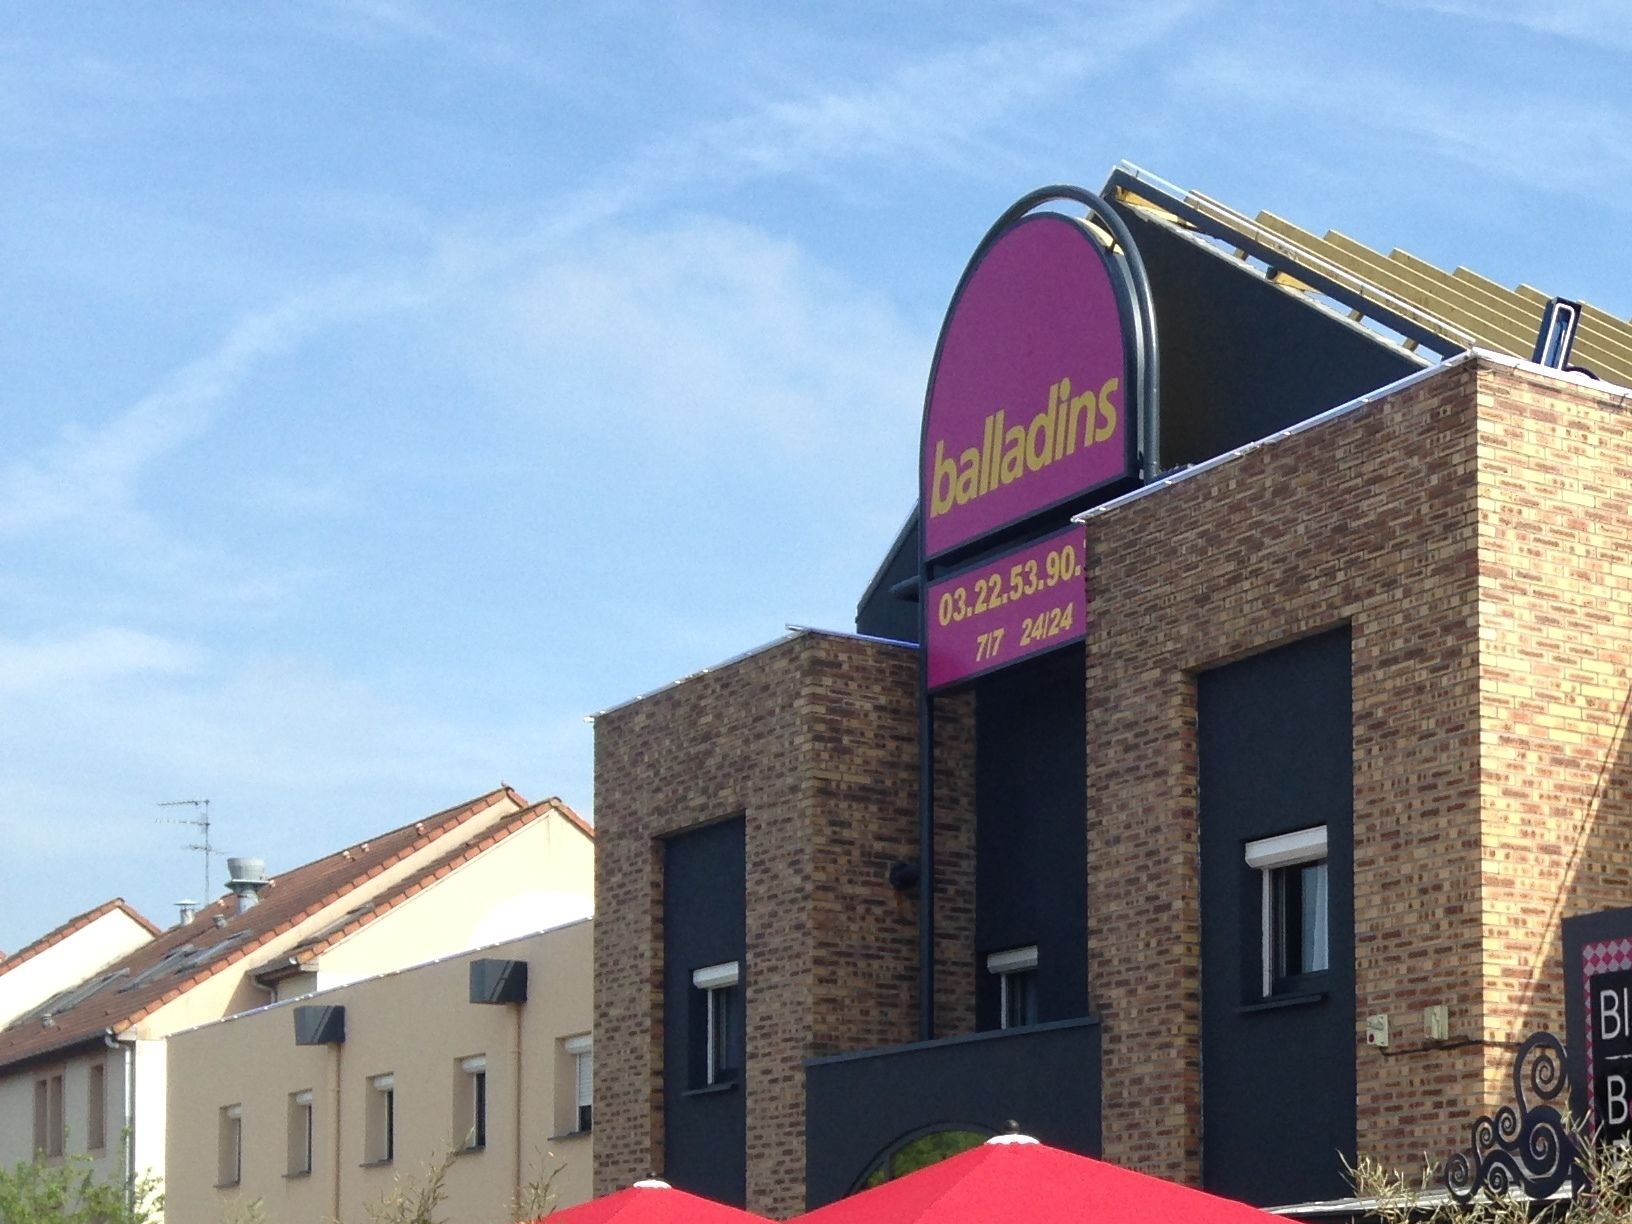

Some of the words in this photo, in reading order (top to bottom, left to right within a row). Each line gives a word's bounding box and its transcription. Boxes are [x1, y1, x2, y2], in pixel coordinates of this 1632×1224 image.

[930, 377, 1119, 518] balladins
[976, 628, 1005, 662] 7/7
[1020, 602, 1073, 646] 24/24
